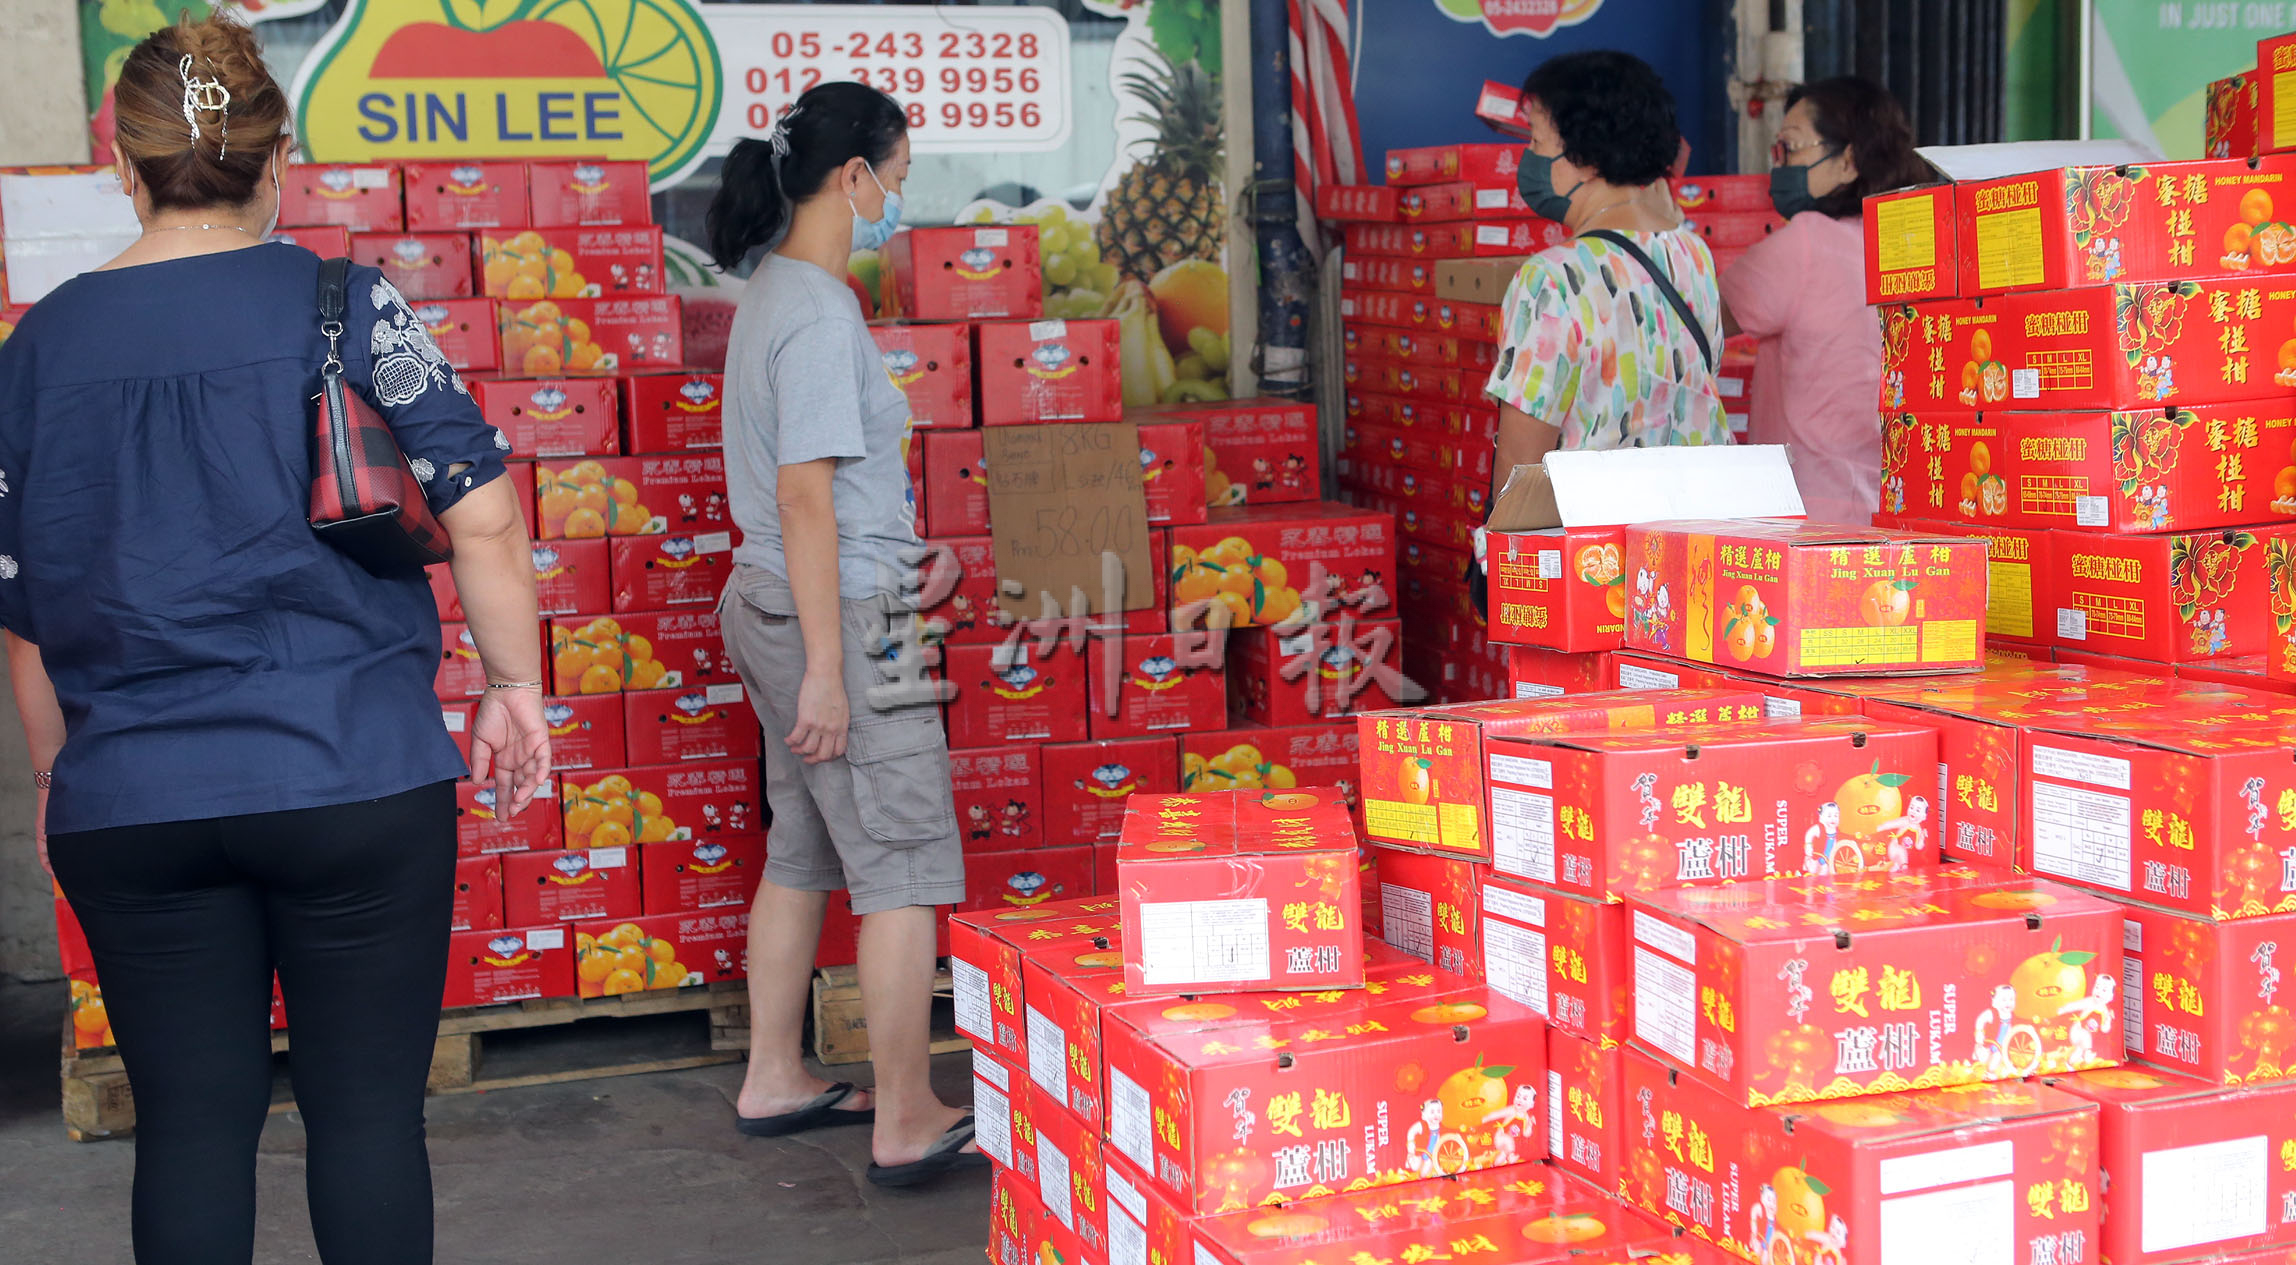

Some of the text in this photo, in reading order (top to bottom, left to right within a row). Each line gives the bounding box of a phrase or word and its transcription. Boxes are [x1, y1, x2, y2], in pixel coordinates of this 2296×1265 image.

[2159, 2, 2286, 29] IN JUST ONE
[939, 33, 1039, 58] 2328
[940, 68, 1040, 94] 9956
[357, 92, 623, 143] SIN LEE
[942, 103, 1041, 128] 9956
[2214, 173, 2283, 186] HONEY MANDARIN
[2268, 290, 2296, 301] HONEY
[1955, 314, 1998, 326] HONEY MANDARIN
[2032, 352, 2088, 364] S M L XL
[1954, 428, 1997, 437] HONEY MANDARIN
[2265, 417, 2292, 429] HONEY
[2026, 478, 2084, 489] S M L XL
[1281, 548, 1340, 561] Premium
[1830, 566, 1951, 580] Jing Xuan Lu Gan
[1722, 570, 1779, 584] Jing Xuan Lu Gan
[2079, 595, 2140, 612] S M L XL
[1377, 741, 1453, 757] Jing Xuan Lu Gan
[1671, 781, 1753, 830] 雙龍
[1956, 773, 1998, 813] 雙龍
[1559, 805, 1594, 841] 雙龍
[1776, 799, 1788, 847] SUPER
[1955, 820, 1996, 857] 蘆柑
[2141, 808, 2195, 851] 雙龍
[1675, 834, 1752, 881] 蘆柑
[1763, 823, 1775, 875] LUKAM
[2143, 859, 2192, 900] 蘆柑
[1282, 901, 1345, 933] 雙龍
[1437, 901, 1465, 936] 雙龍
[1286, 945, 1342, 974] 蘆柑
[1552, 944, 1588, 985] 雙龍
[1701, 984, 1736, 1033] 雙龍
[1829, 964, 1921, 1019] 雙龍
[1943, 982, 1957, 1035] SUPER
[2153, 971, 2205, 1017] 雙龍
[1834, 1021, 1921, 1075] 蘆柑
[1928, 1009, 1943, 1065] LUKAM
[2154, 1023, 2202, 1066] 蘆柑
[1266, 1087, 1351, 1137] 雙龍
[1376, 1100, 1389, 1147] SUPER
[1568, 1086, 1603, 1129] 雙龍
[1364, 1124, 1376, 1175] LUKAM
[1662, 1109, 1714, 1174] 雙龍
[1272, 1138, 1351, 1190] 蘆柑
[1664, 1166, 1716, 1228] 蘆柑
[1730, 1161, 1739, 1213] SUPER
[2026, 1178, 2090, 1219] 雙龍
[1721, 1182, 1733, 1239] LUKAM
